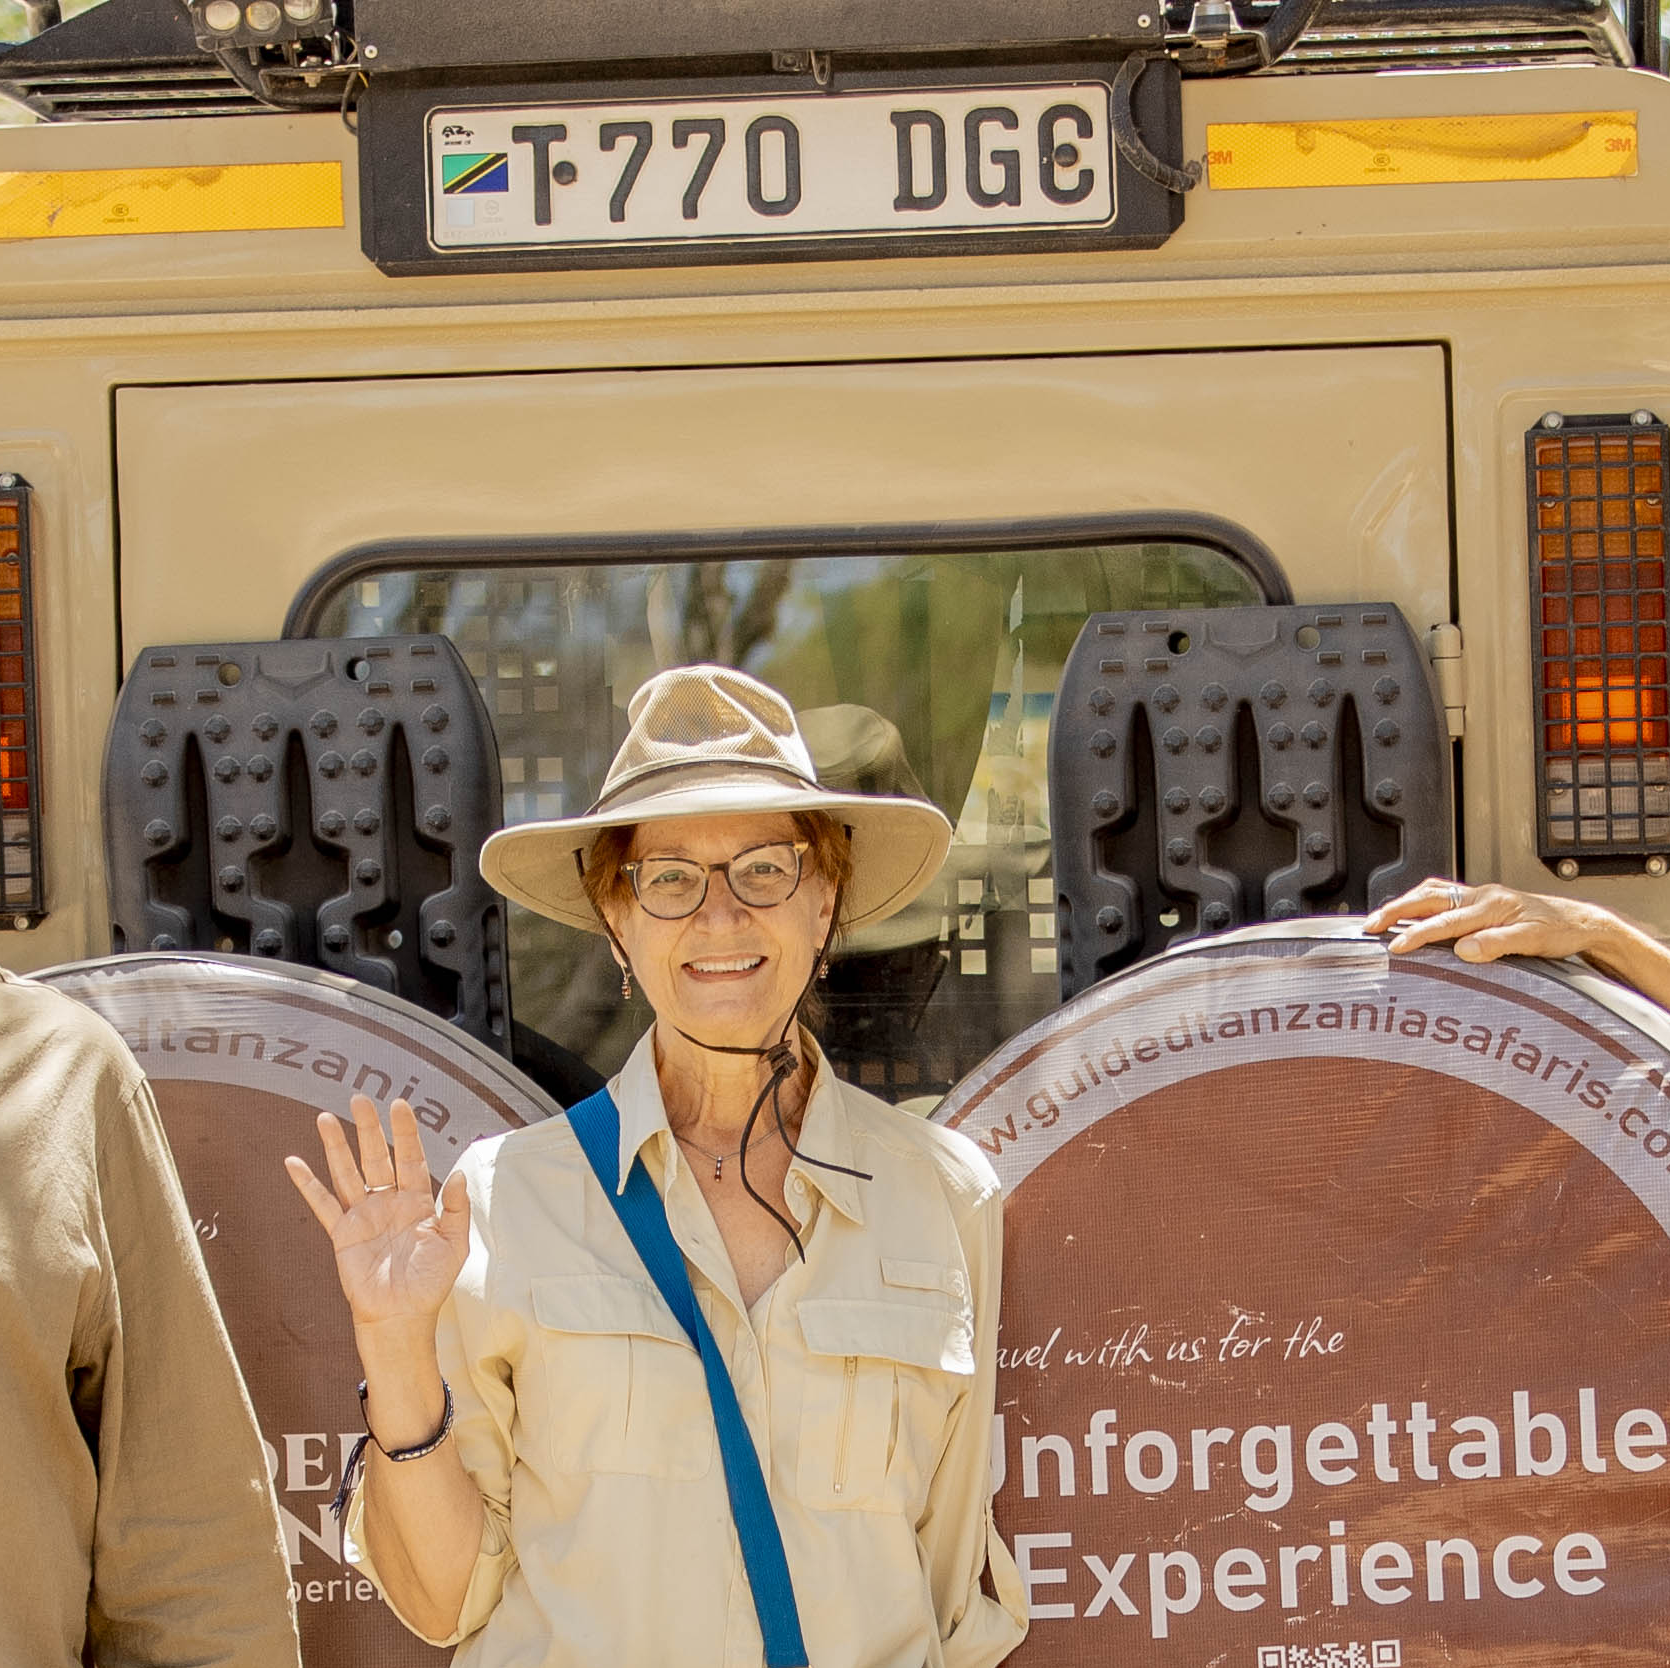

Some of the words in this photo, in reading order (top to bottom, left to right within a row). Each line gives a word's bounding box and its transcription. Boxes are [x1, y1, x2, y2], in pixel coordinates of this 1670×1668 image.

[995, 1326, 1062, 1370] avel
[1064, 1324, 1154, 1369] with
[1166, 1336, 1207, 1363] us
[1218, 1313, 1272, 1363] for
[1283, 1315, 1346, 1362] the
[1014, 1520, 1609, 1640] Experience
